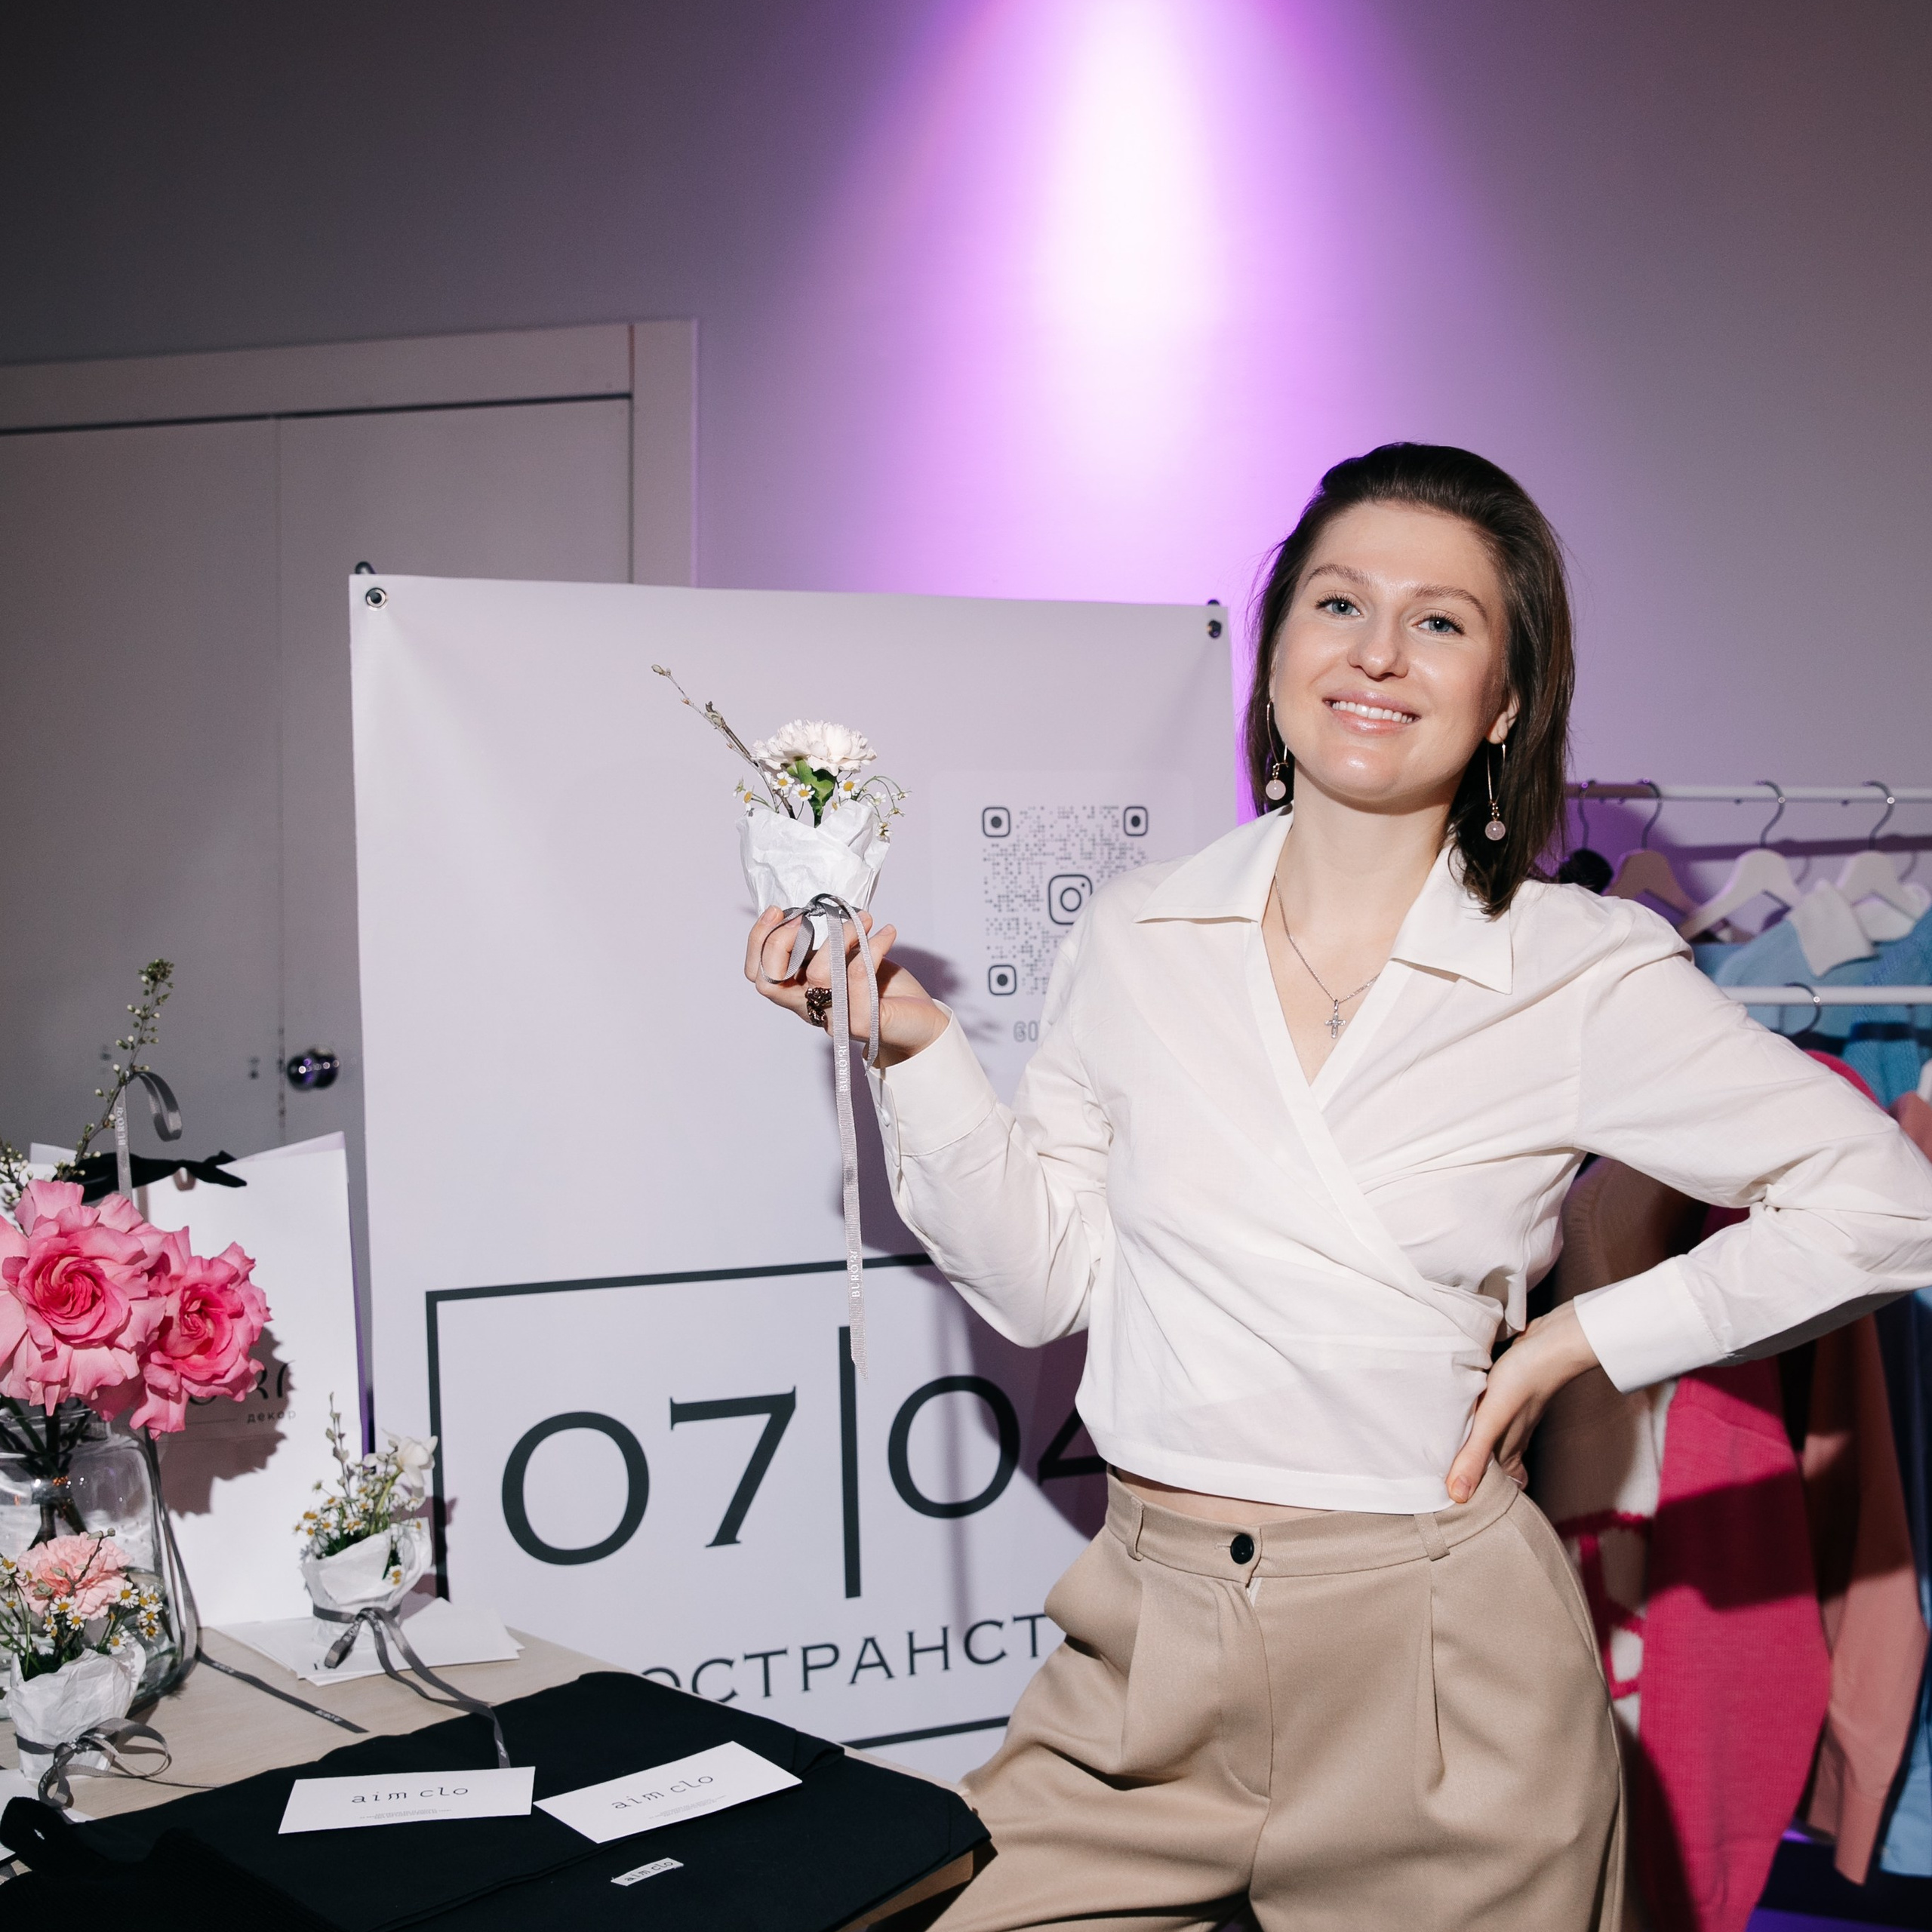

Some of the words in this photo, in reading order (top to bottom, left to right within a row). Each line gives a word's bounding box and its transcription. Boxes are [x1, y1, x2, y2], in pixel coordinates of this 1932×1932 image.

[246, 1410, 297, 1424] декор
[351, 1791, 408, 1804] aim
[420, 1786, 469, 1798] clo
[611, 1791, 665, 1810] aim
[669, 1776, 714, 1793] clo
[624, 1869, 651, 1881] aim
[651, 1861, 674, 1871] clo
